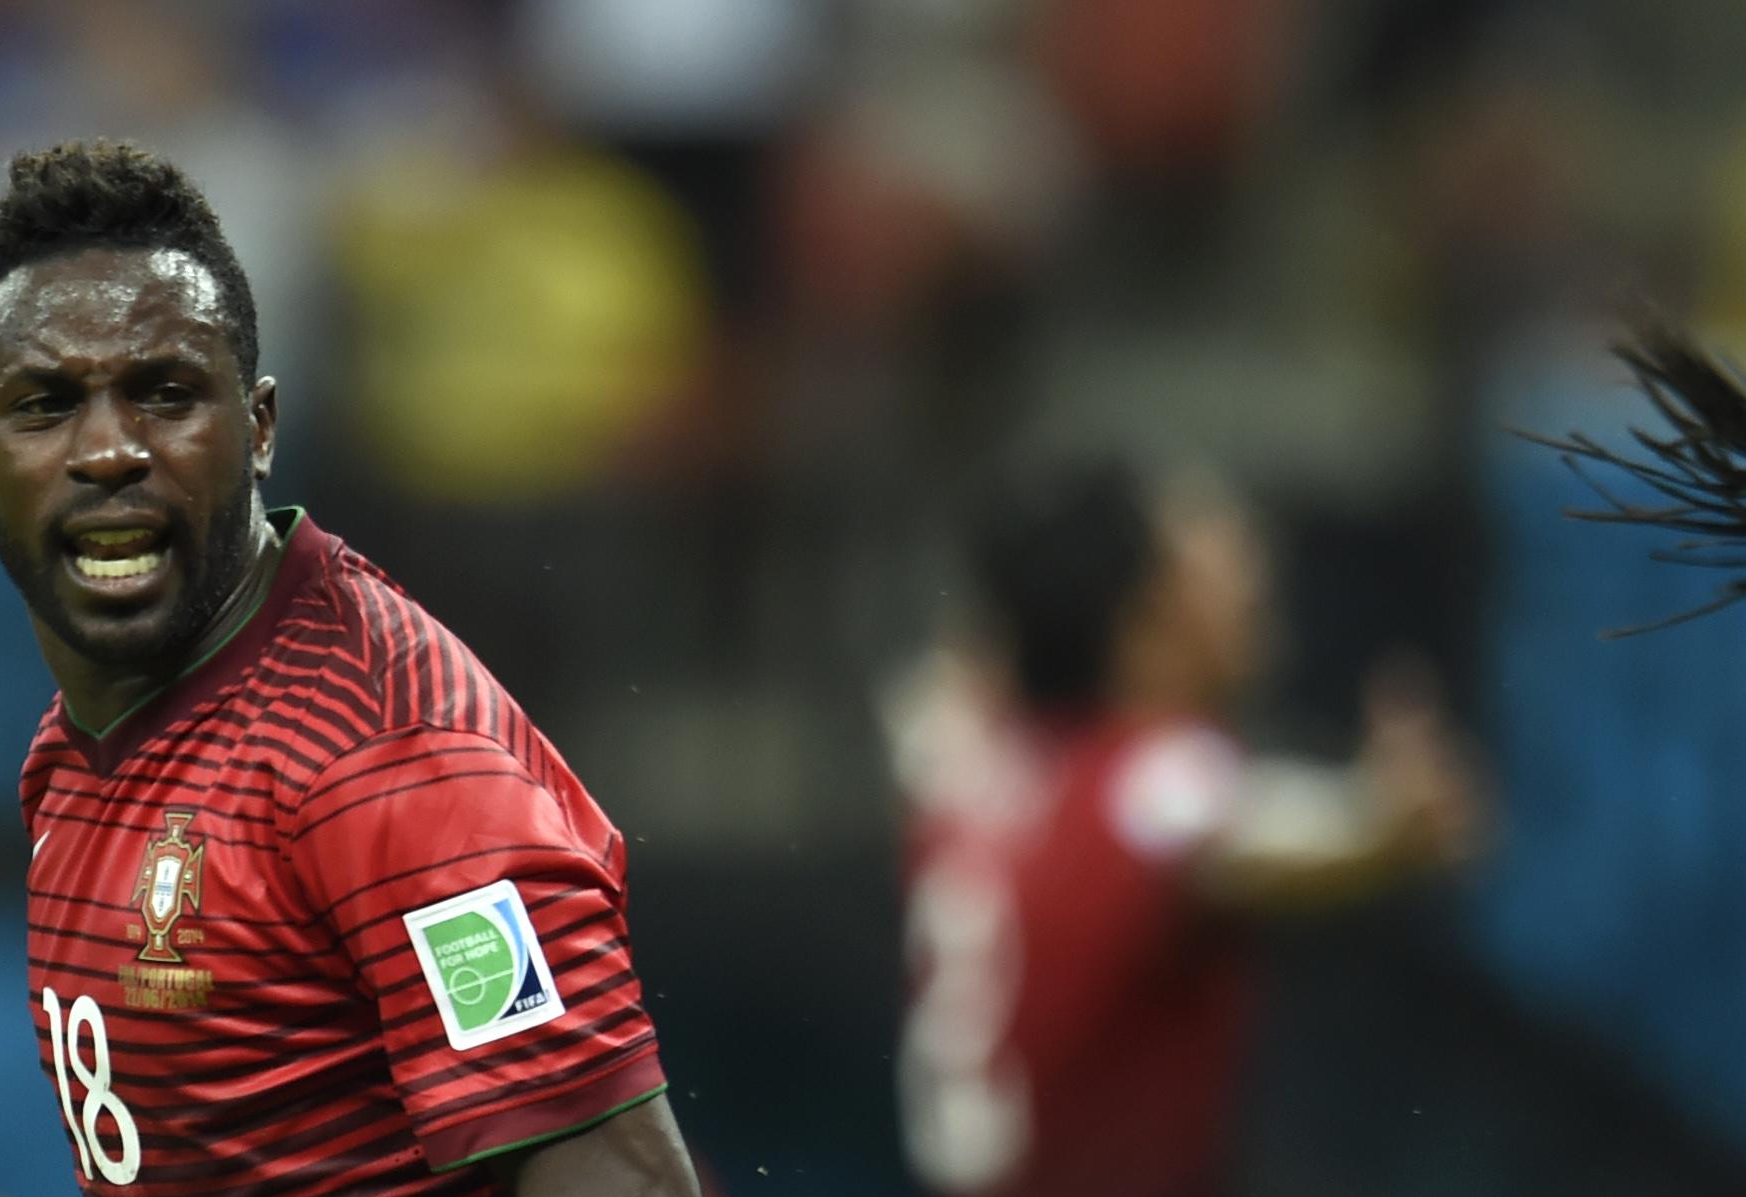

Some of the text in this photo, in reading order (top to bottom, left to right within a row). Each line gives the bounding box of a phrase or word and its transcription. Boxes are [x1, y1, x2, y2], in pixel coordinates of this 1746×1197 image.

[434, 929, 498, 959] FOOTBALL
[439, 941, 499, 970] FOR HOPE
[514, 991, 547, 1012] FIFA
[42, 985, 142, 1186] 18
